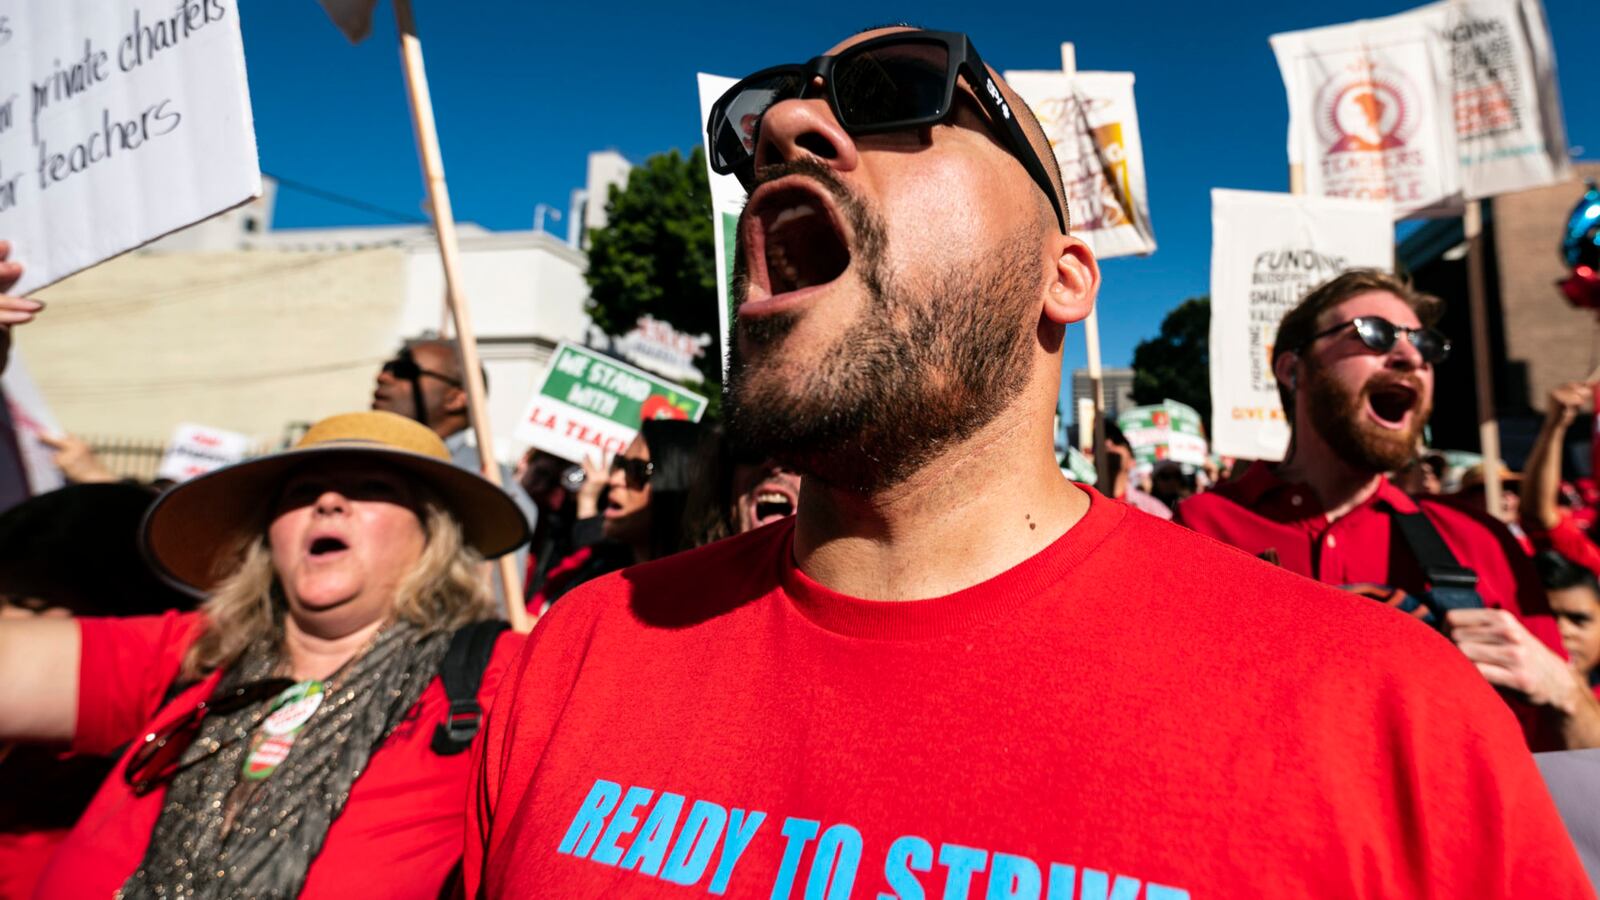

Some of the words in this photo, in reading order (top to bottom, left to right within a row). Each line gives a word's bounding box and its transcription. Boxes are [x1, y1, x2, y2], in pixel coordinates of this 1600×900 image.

[31, 37, 108, 146] private
[117, 0, 225, 73] charters
[39, 98, 181, 190] teachers
[556, 350, 591, 378] WE
[587, 362, 652, 402] STAND
[566, 382, 619, 417] WITH
[558, 779, 767, 894] READY
[770, 816, 863, 900] TO
[877, 835, 1192, 900] STRI
